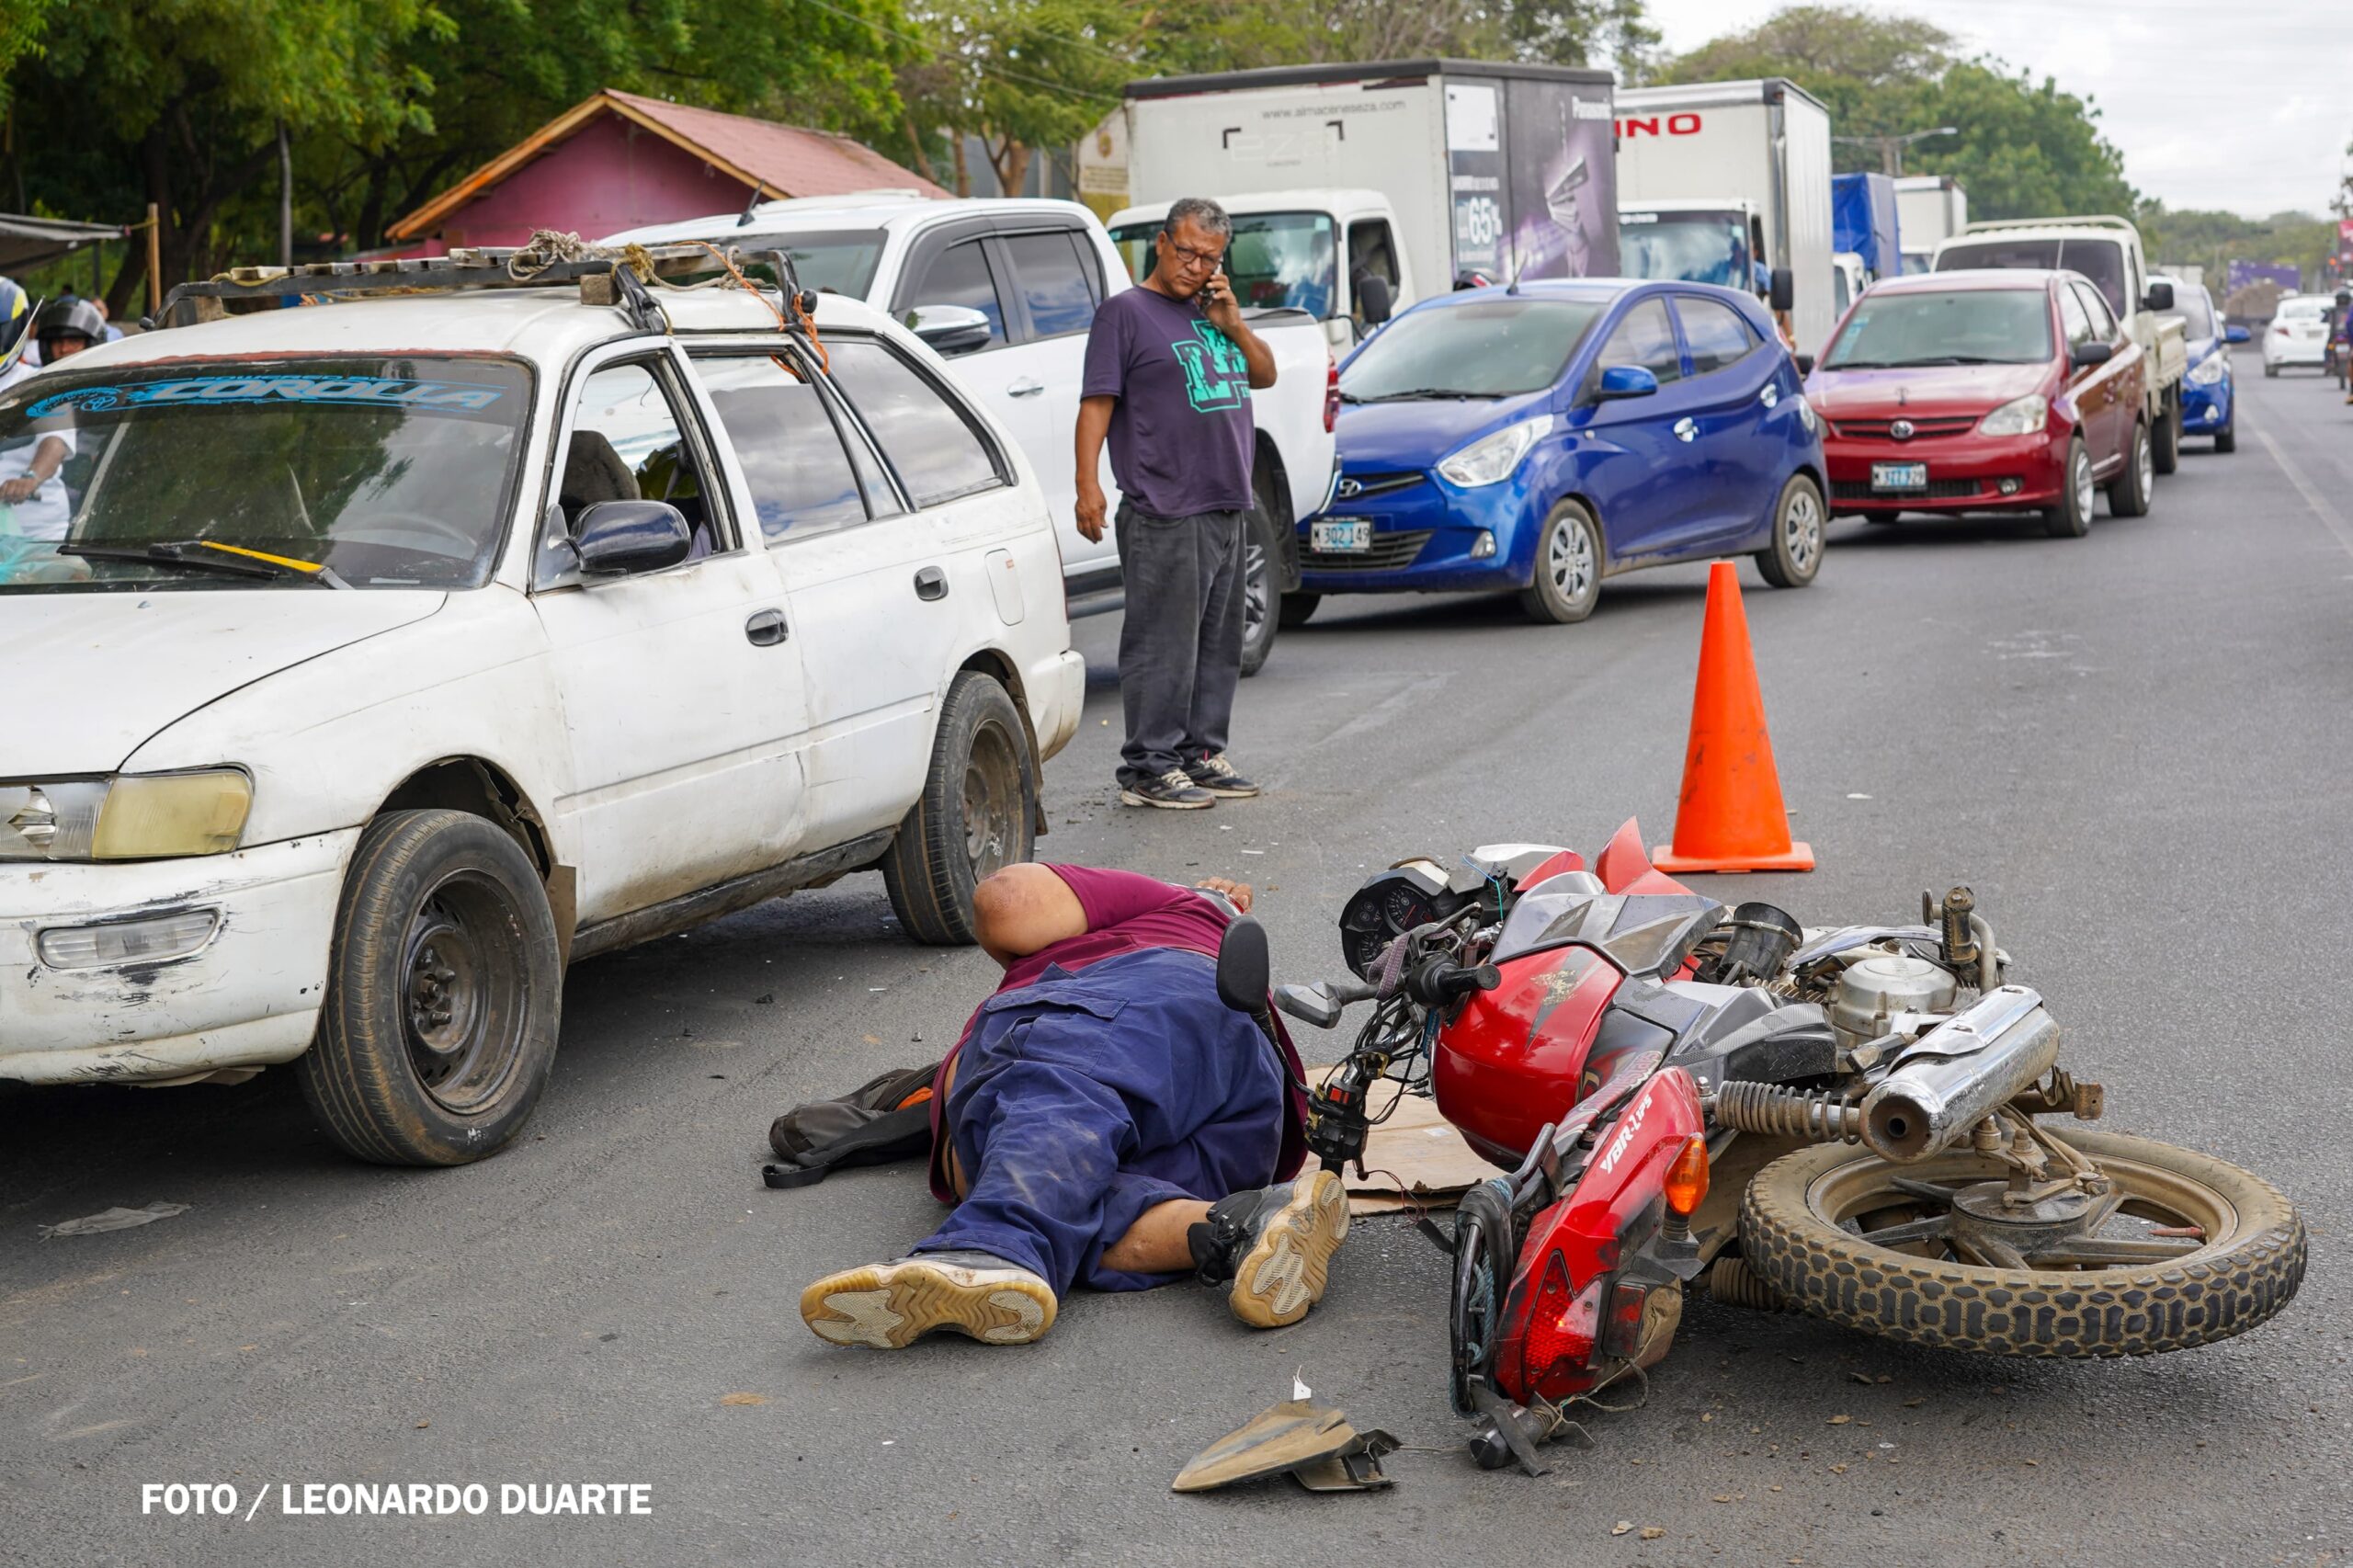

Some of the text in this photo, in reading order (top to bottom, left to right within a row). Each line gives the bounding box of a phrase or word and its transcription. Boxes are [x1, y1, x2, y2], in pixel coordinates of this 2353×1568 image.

[1261, 99, 1406, 119] www.almaceneseza.com
[1615, 114, 1701, 138] INO
[150, 378, 502, 410] COROLLA
